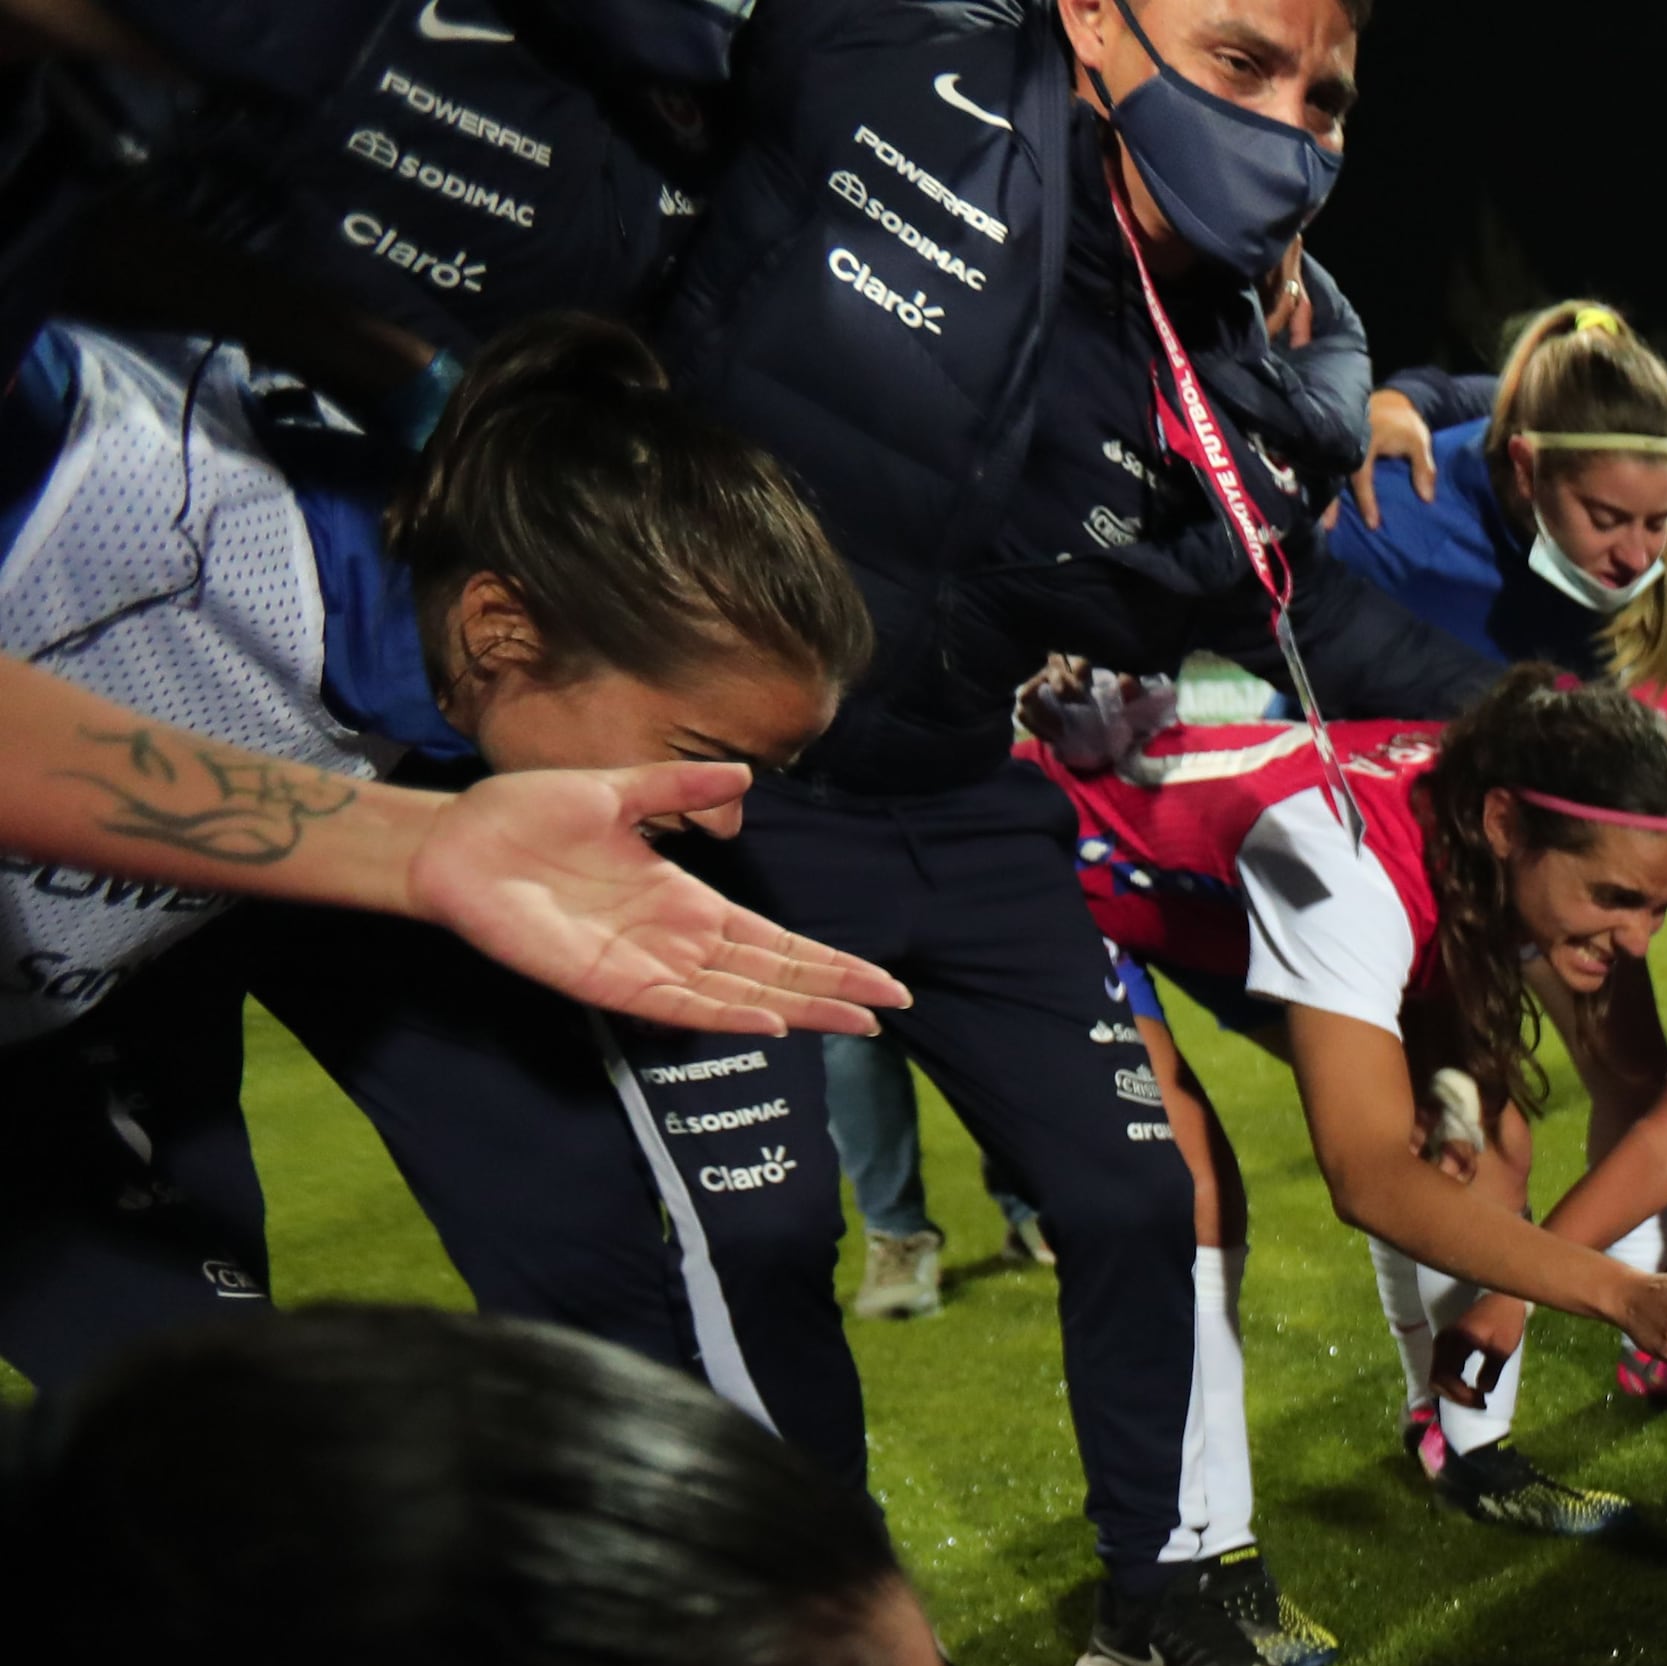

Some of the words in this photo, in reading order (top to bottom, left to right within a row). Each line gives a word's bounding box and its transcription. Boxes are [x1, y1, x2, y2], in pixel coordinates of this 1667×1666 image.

[379, 69, 553, 168] POWERADE
[399, 155, 536, 228] SODIMAC
[854, 125, 1008, 244] POWERADE
[343, 212, 474, 291] Claro
[864, 198, 987, 291] SODIMAC
[829, 248, 932, 331] Claro
[1181, 369, 1229, 469] FUTBOL
[686, 1098, 790, 1134] SODIMAC
[699, 1152, 790, 1192] Claro
